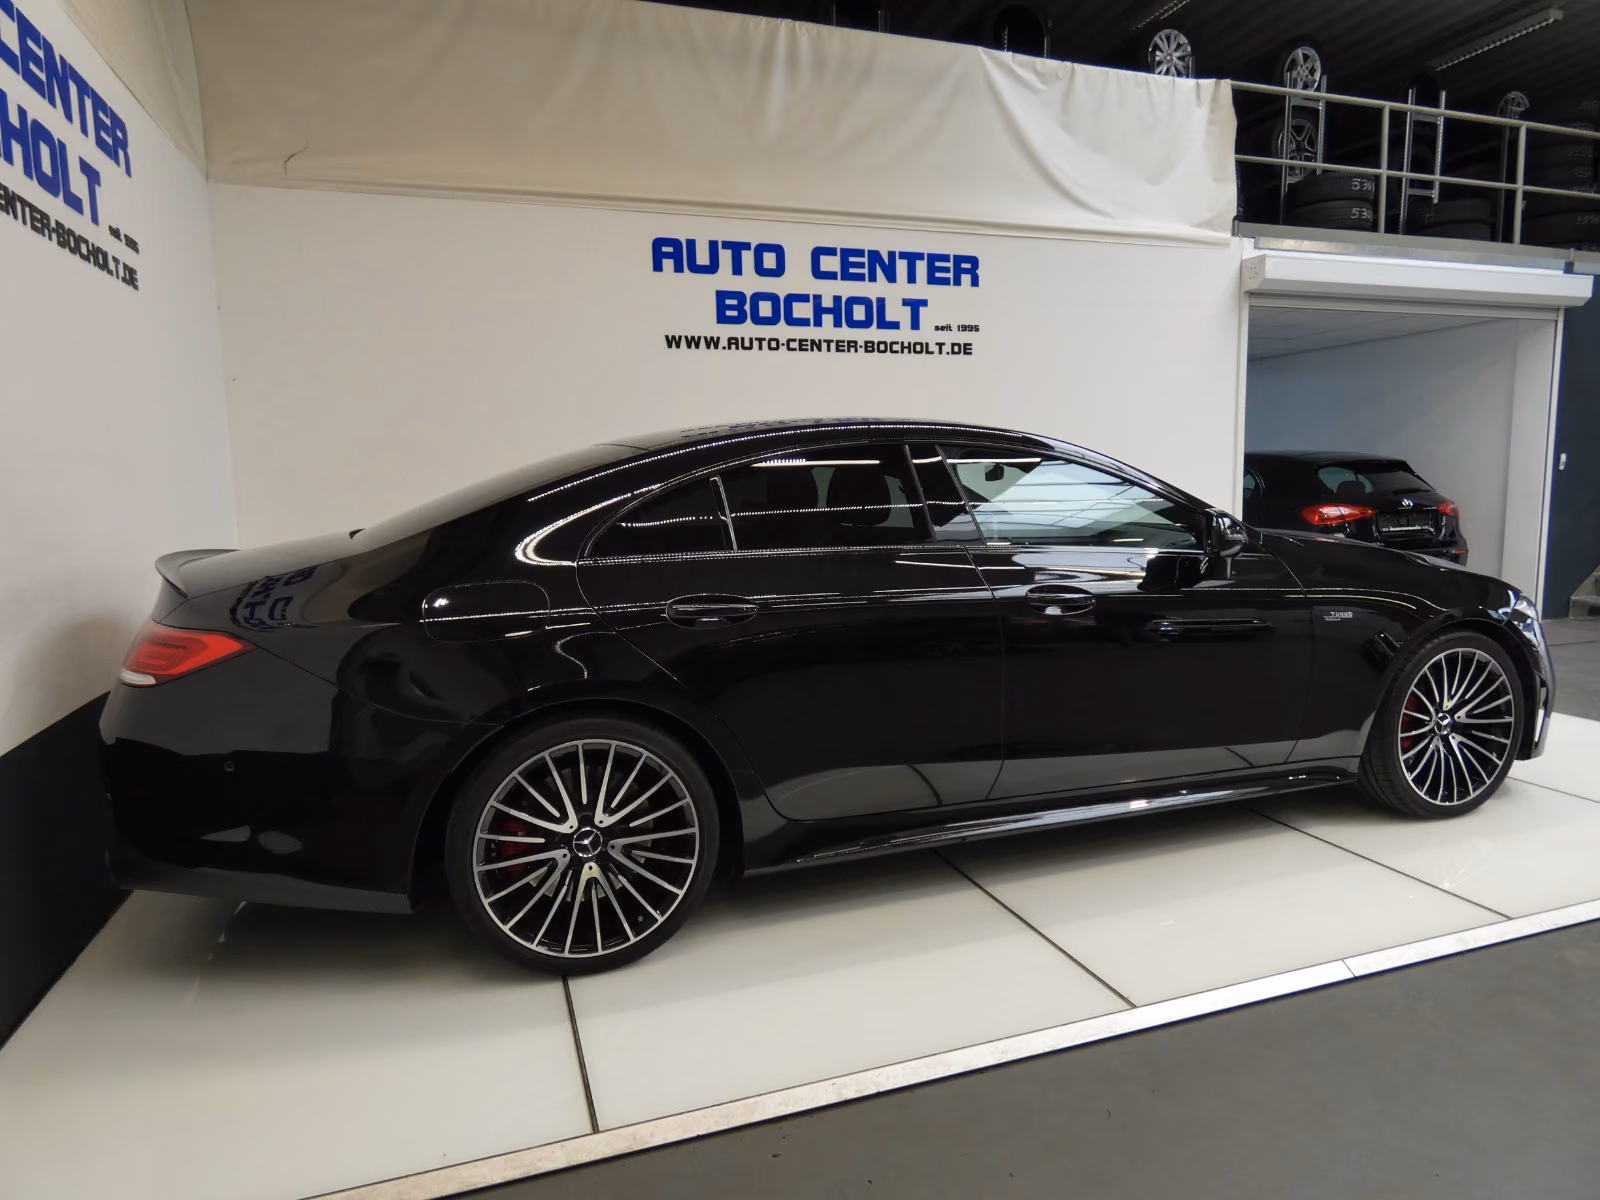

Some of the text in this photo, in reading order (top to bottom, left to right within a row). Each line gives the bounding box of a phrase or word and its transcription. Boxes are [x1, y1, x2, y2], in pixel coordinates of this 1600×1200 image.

[0, 88, 102, 227] HOLT
[652, 237, 980, 288] AUTO CENTER
[715, 289, 928, 331] BOCHOLT
[957, 324, 980, 332] 1995
[664, 334, 973, 356] WWW.AUTO-CENTER-BOCHOLT.DE
